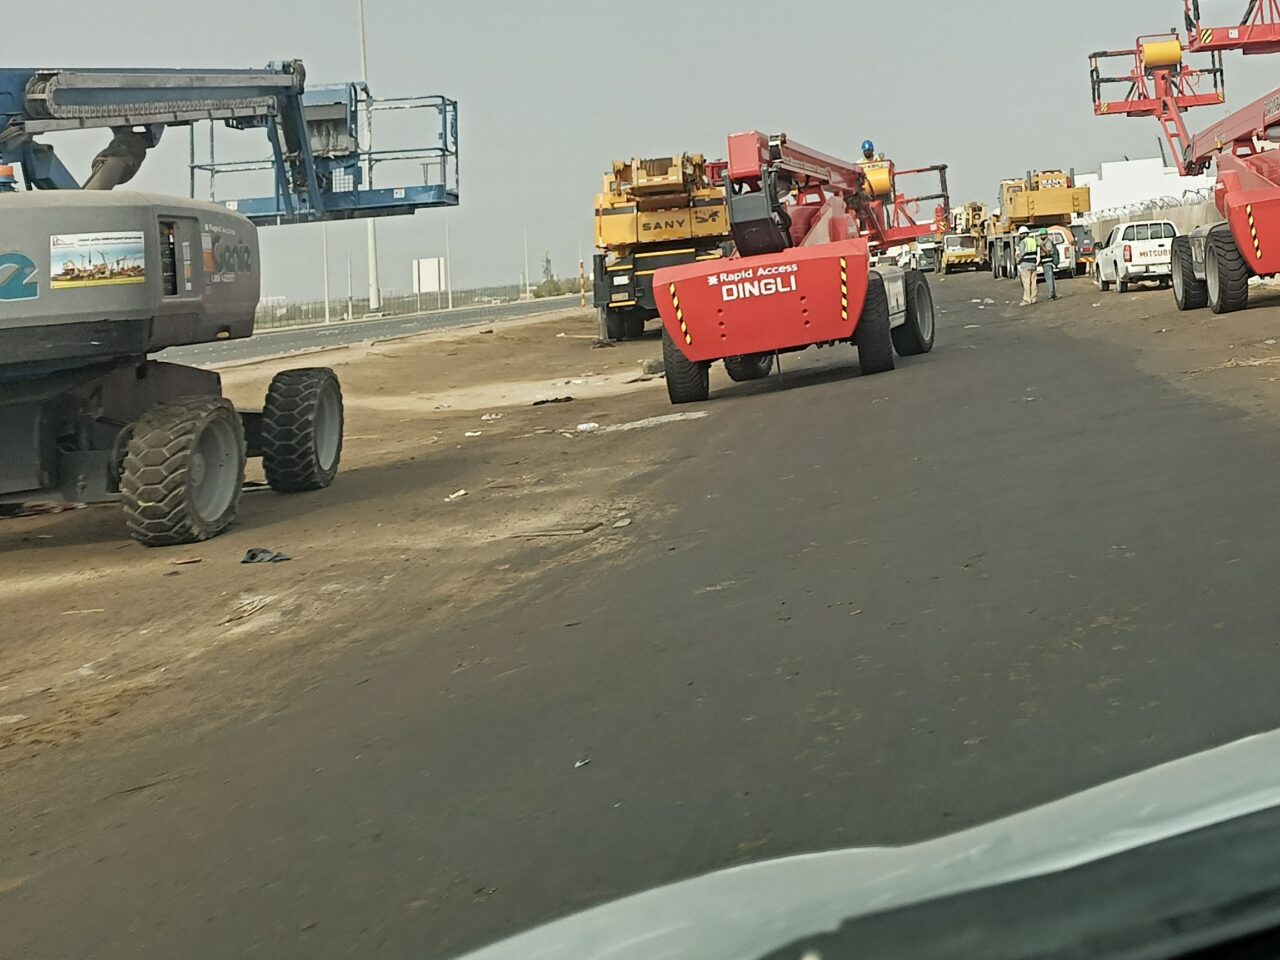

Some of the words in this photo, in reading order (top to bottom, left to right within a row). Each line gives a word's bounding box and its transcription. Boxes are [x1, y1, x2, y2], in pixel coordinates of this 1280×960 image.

[642, 219, 685, 232] SANY
[1139, 248, 1171, 257] MITSUBI
[0, 251, 39, 302] 2
[719, 268, 753, 282] Rapid
[757, 263, 798, 277] Access
[721, 274, 797, 302] DINGLI
